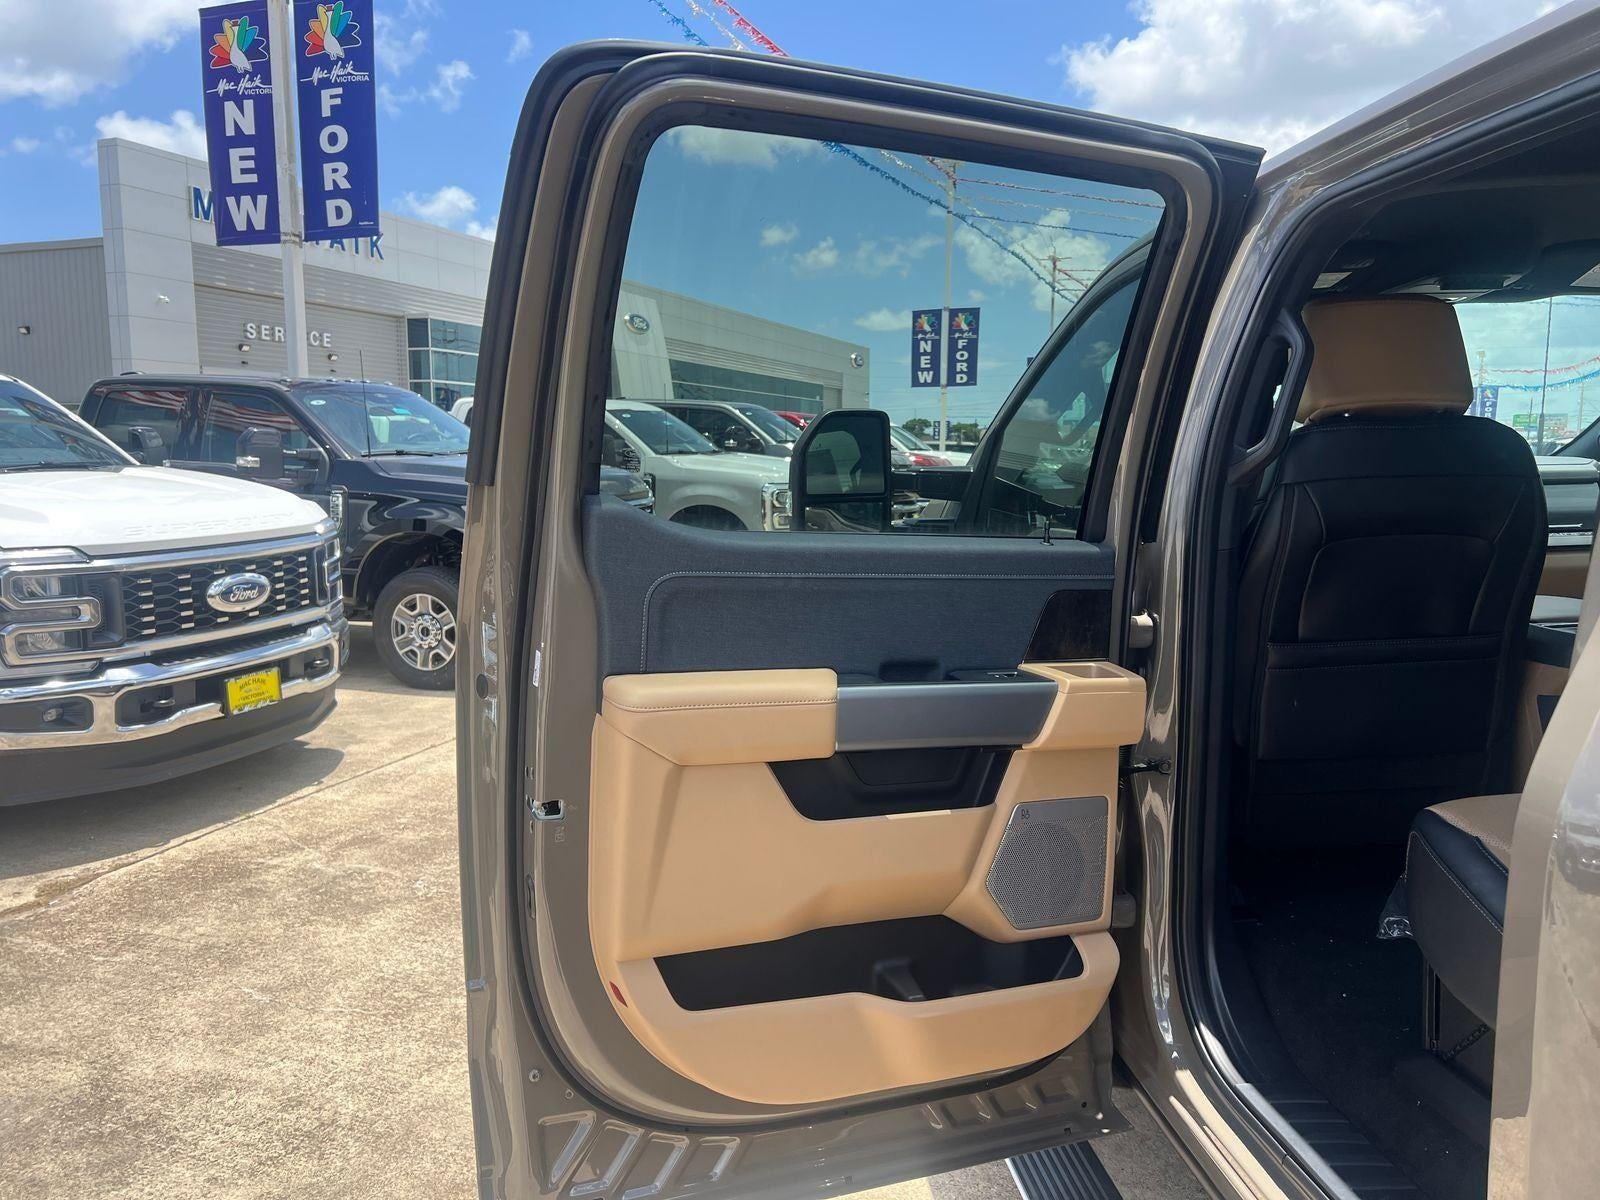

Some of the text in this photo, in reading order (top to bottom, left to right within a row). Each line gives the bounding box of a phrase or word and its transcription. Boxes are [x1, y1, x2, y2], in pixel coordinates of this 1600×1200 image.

[215, 74, 266, 97] Mac Haik
[310, 60, 361, 86] Mac Haik
[336, 75, 370, 84] VICTORIA
[243, 87, 273, 96] VICTORI
[223, 98, 268, 232] NEW
[319, 87, 352, 228] FORD
[246, 322, 332, 348] SERCE
[917, 340, 934, 384] NEW
[955, 339, 969, 384] FORD
[229, 583, 260, 602] Ford
